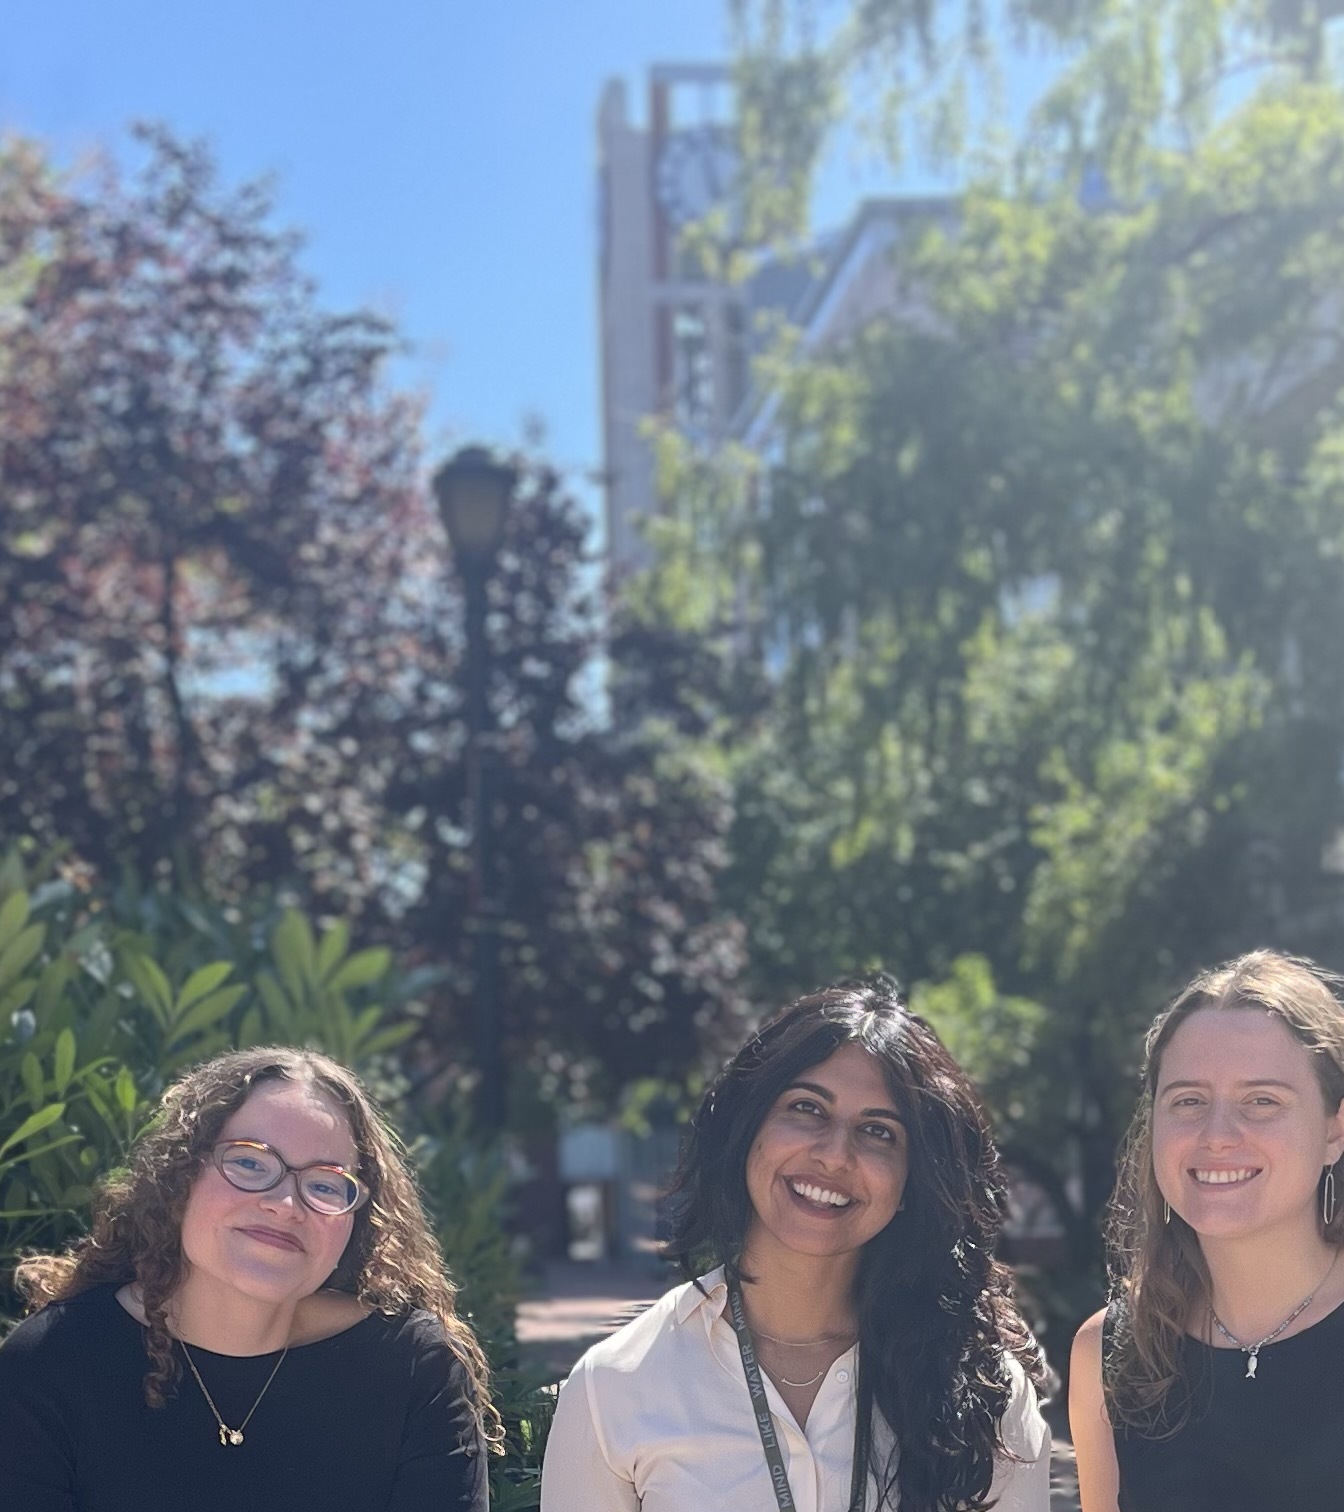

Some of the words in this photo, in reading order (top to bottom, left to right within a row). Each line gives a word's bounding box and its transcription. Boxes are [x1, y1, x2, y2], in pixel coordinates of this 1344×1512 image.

[731, 1291, 747, 1332] MIND
[741, 1343, 763, 1399] WATER
[757, 1412, 776, 1449] LIKE
[772, 1464, 794, 1509] MIND
